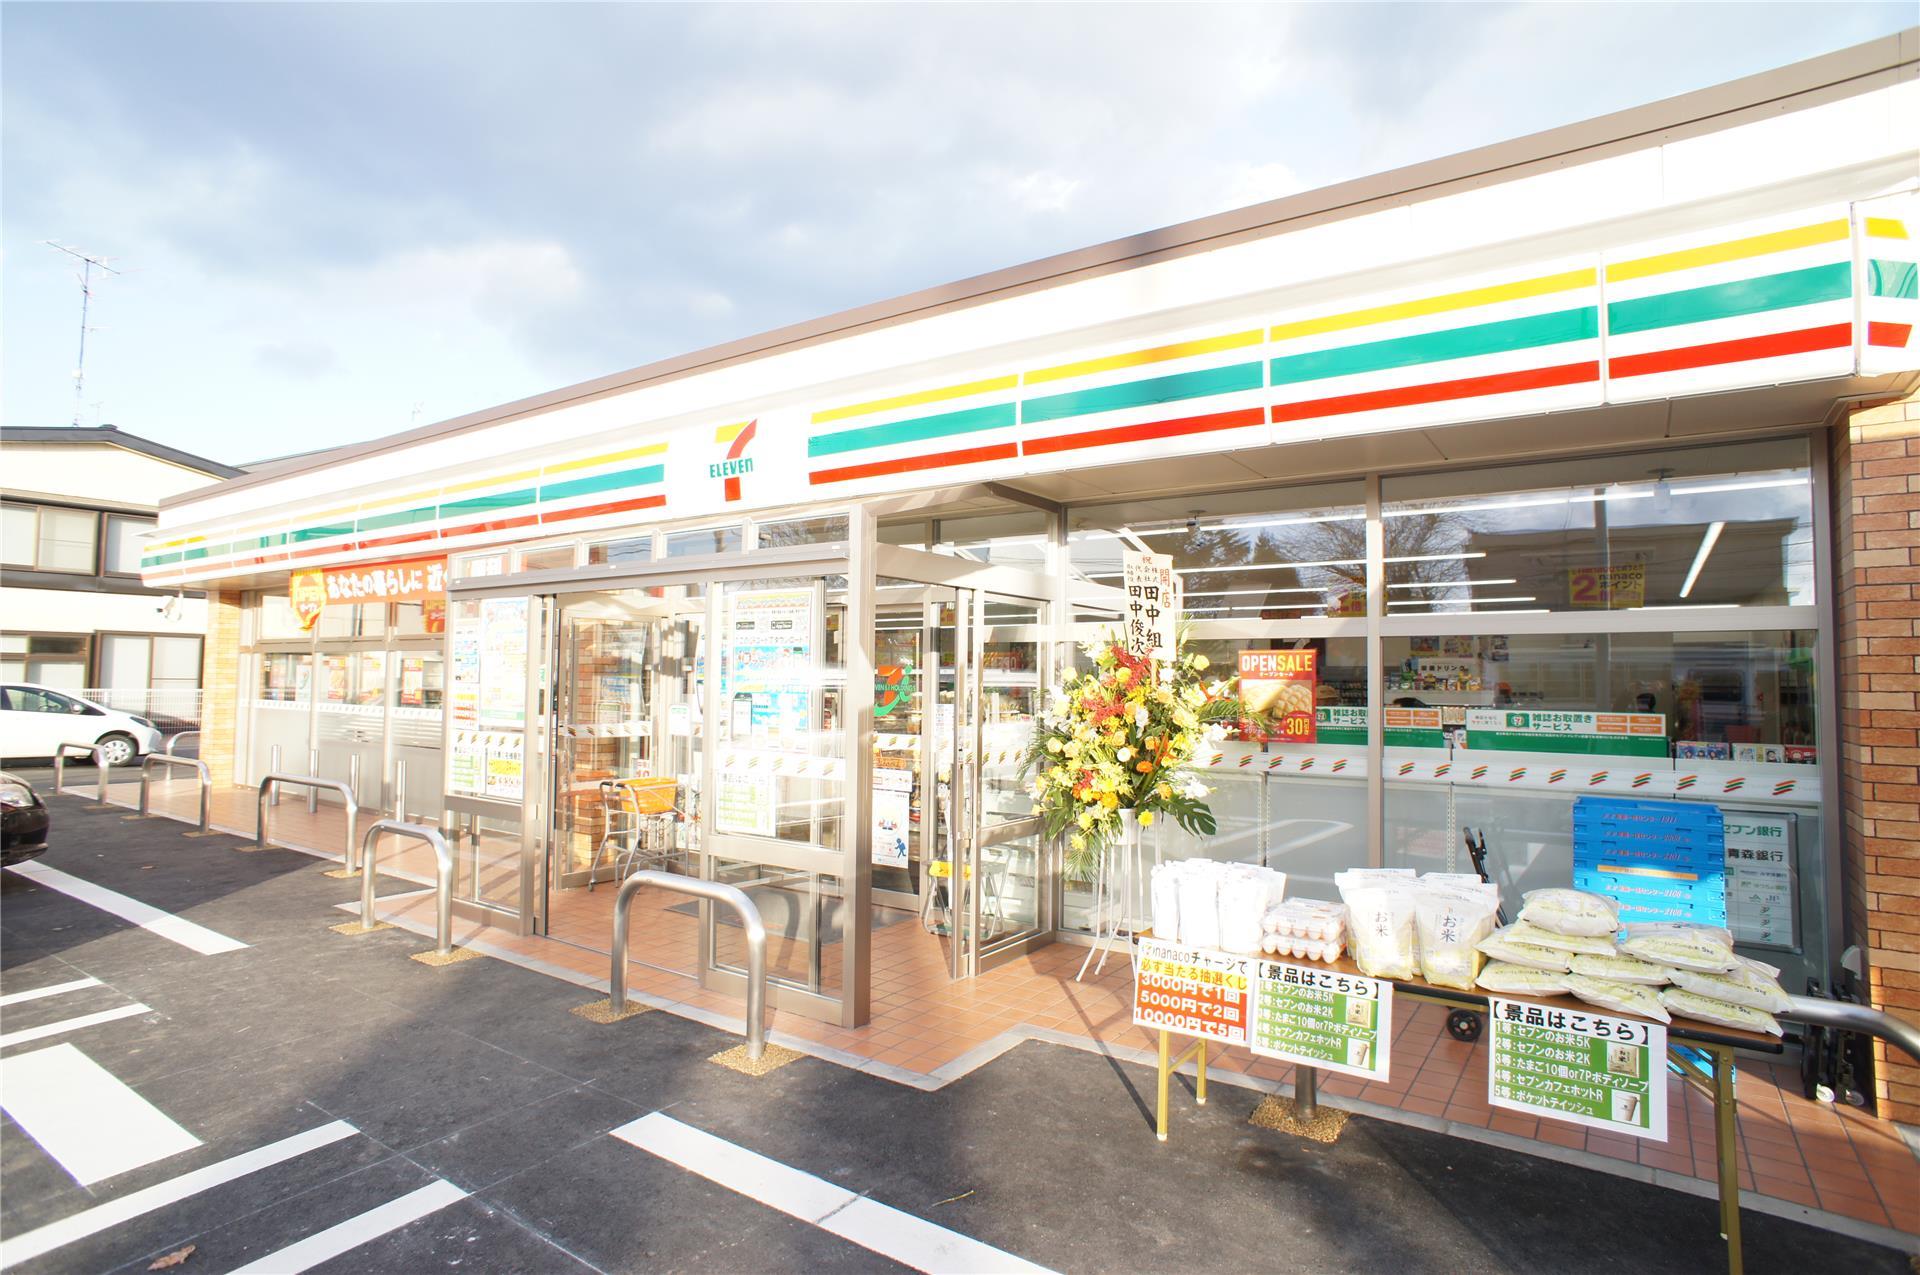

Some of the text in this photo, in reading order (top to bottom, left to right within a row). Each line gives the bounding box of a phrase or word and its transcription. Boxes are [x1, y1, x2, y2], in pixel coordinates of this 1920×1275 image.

[1159, 568, 1171, 608] 開店
[1128, 585, 1146, 655] 田中俊次
[1143, 585, 1163, 648] 田中組
[1332, 709, 1368, 717] 雑誌お取
[1333, 717, 1366, 725] サービス
[1532, 723, 1572, 731] サービス
[1727, 847, 1784, 862] 青森銀行
[1374, 911, 1389, 937] お米
[1440, 915, 1457, 943] お米
[1140, 989, 1240, 1022] 5000円で2回
[1135, 1006, 1245, 1039] 10000円で5回
